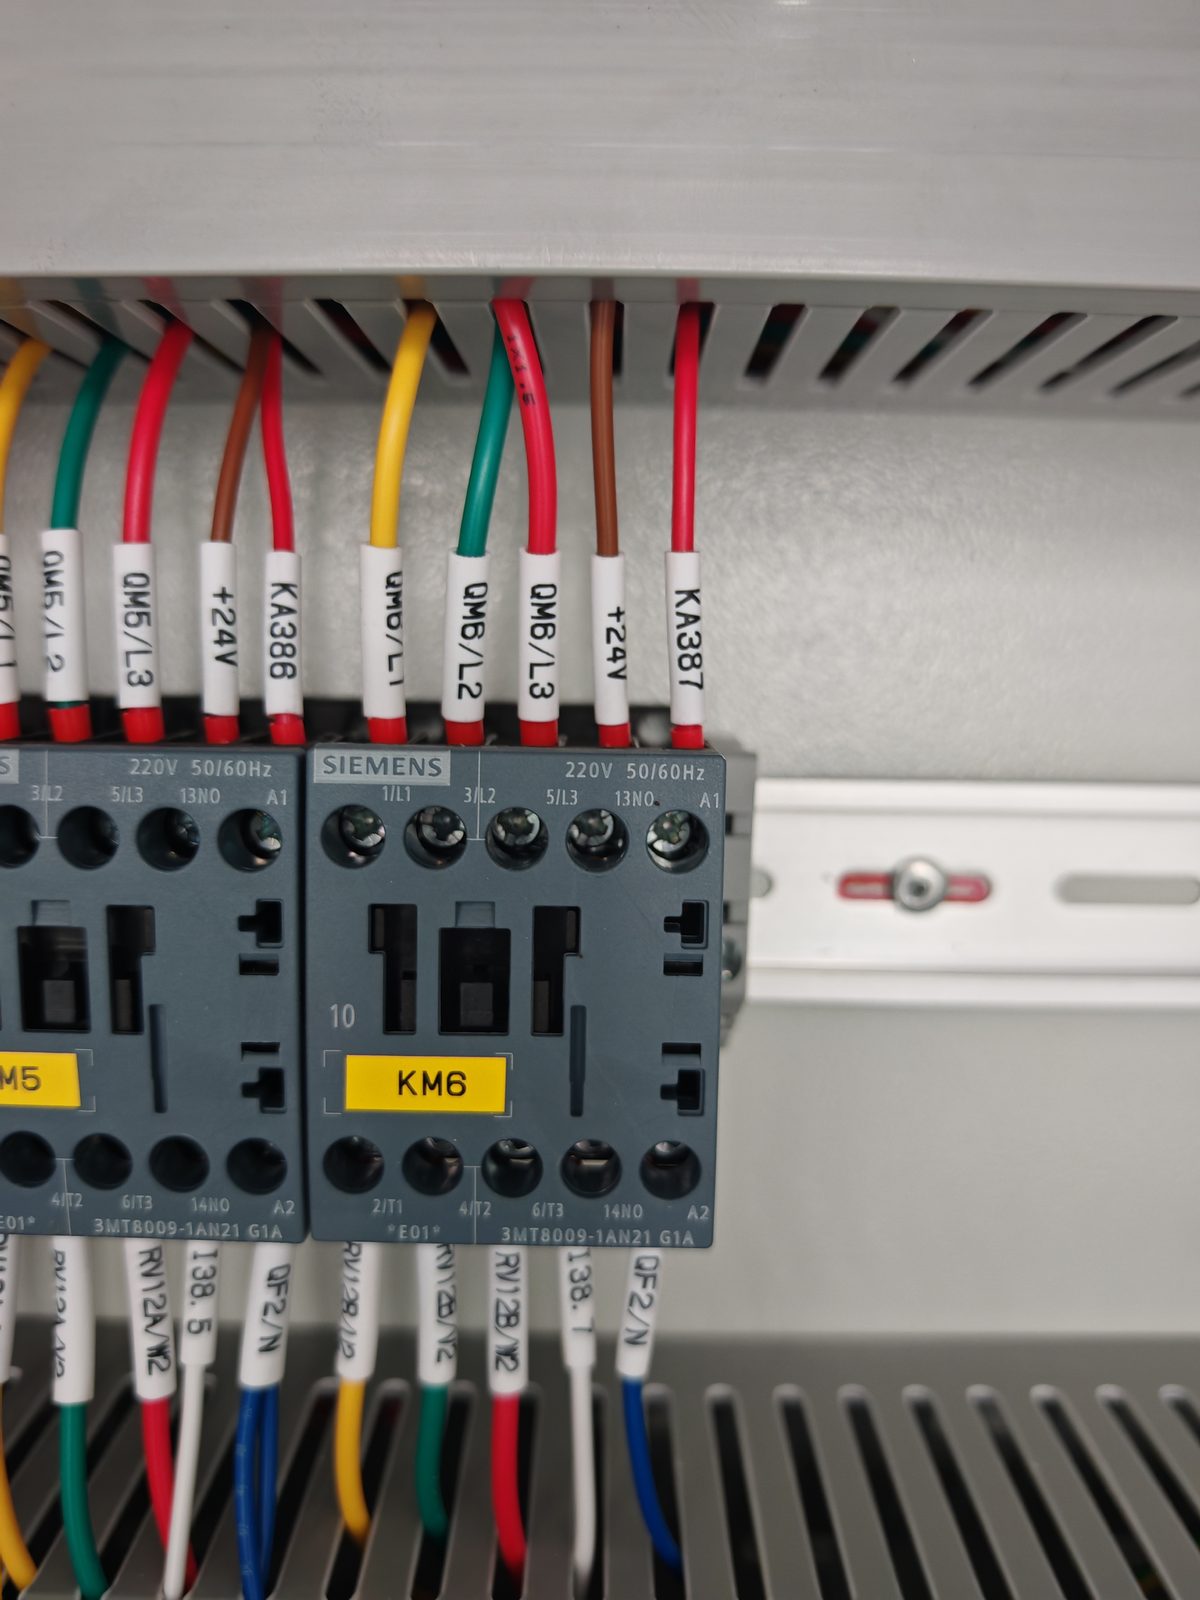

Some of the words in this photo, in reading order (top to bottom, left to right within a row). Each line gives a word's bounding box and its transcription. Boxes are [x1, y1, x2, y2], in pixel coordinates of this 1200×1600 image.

[123, 572, 154, 687] QM5/L3
[212, 587, 238, 666] +24V
[269, 582, 298, 679] KA386
[457, 582, 488, 700] QM6/L2
[529, 584, 557, 699] QM6/L3
[606, 606, 627, 680] +24V
[674, 588, 704, 690] KA387
[130, 758, 178, 776] 220V
[191, 759, 272, 777] 50/60Hz
[323, 755, 442, 777] SIEMENS
[565, 762, 613, 779] 220V
[627, 763, 705, 781] 50/60Hz
[111, 786, 143, 803] 5/L3
[266, 789, 288, 806] A1
[382, 785, 411, 802] 1/L1
[464, 787, 496, 804] 3/L2
[546, 788, 578, 806] 5/L3
[700, 792, 720, 808] A1
[330, 1003, 356, 1029] 10
[0, 1065, 42, 1091] M5
[398, 1069, 467, 1096] KM6
[121, 1194, 153, 1210] 6/T3
[273, 1199, 296, 1215] A2
[372, 1198, 402, 1214] 2/T1
[459, 1201, 492, 1216] 4/T2
[532, 1202, 564, 1218] 6/T3
[687, 1204, 710, 1220] A2
[0, 1215, 36, 1231] E01
[94, 1218, 240, 1238] 3MT8009-1AN21
[249, 1223, 283, 1240] G1A
[501, 1226, 651, 1244] 3MT8009-1AN21
[659, 1229, 695, 1246] G1A
[257, 1263, 291, 1353] QF2/N
[623, 1255, 660, 1346] QF2/N
